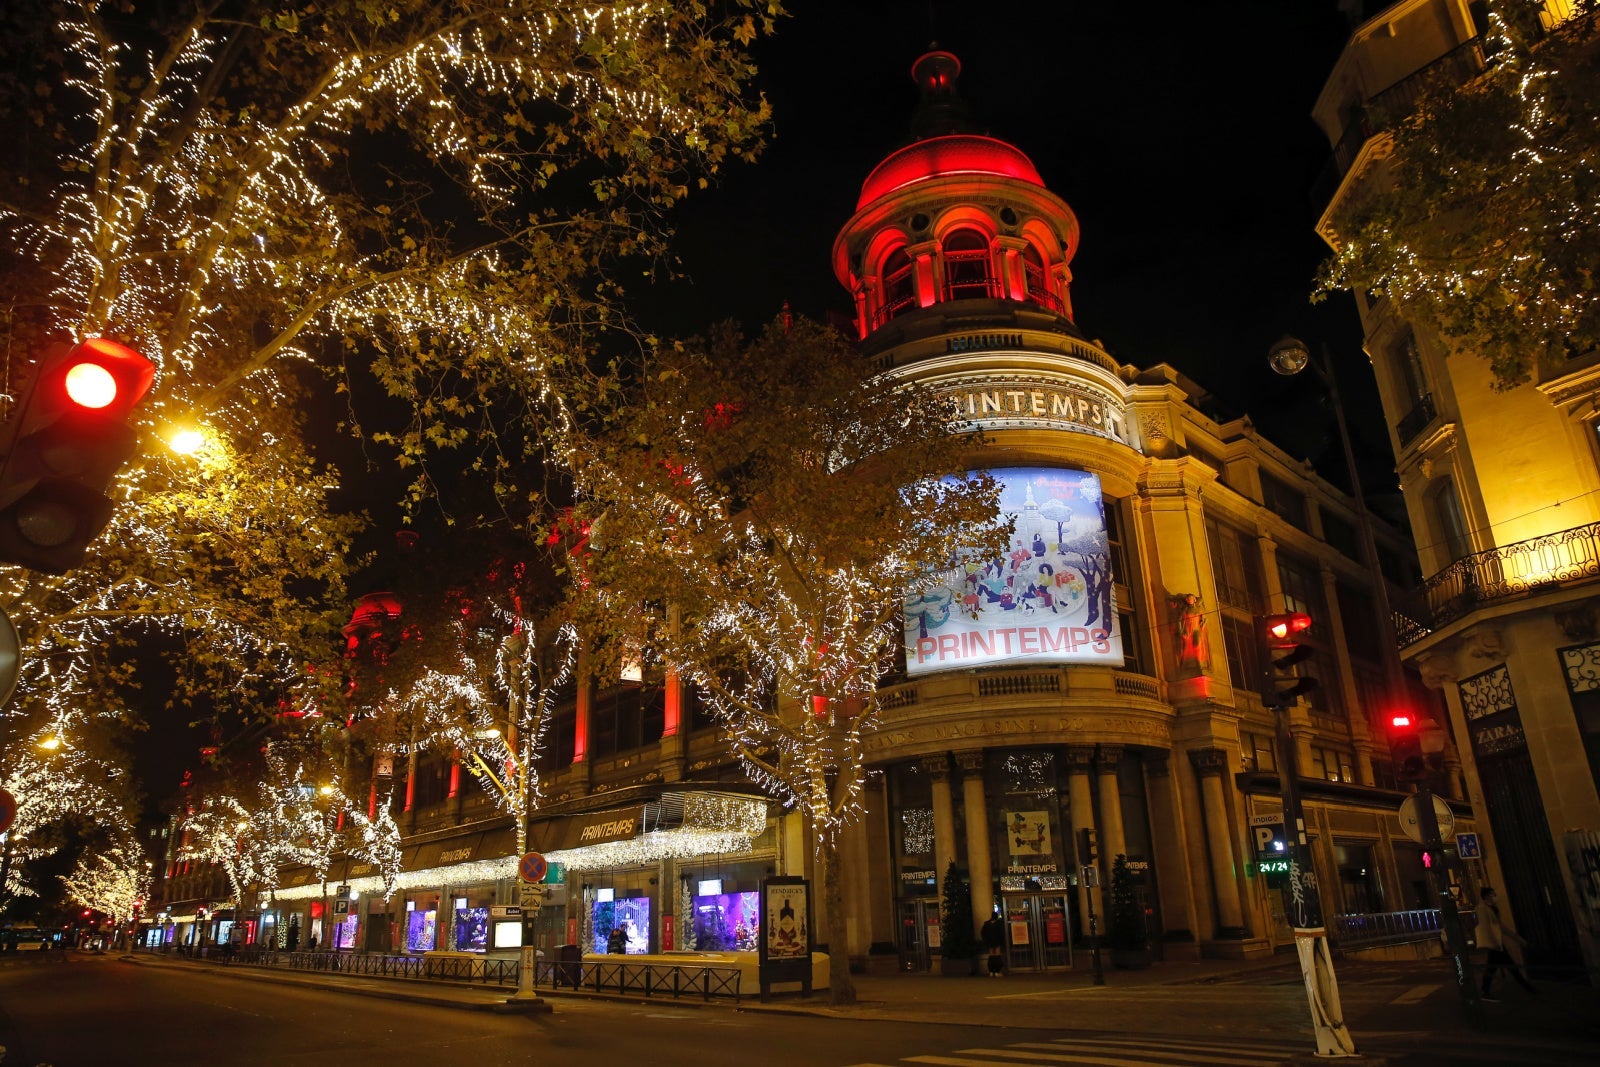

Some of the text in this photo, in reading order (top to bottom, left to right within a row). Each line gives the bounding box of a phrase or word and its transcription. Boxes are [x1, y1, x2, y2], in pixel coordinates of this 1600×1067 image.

[916, 627, 1110, 664] PRINTEMPS
[935, 719, 1036, 738] MAGASINS
[1059, 717, 1085, 731] DU
[1477, 724, 1517, 744] ZARA
[1253, 815, 1278, 824] INDIGO
[580, 818, 634, 841] PRINTEMPS
[1255, 827, 1274, 852] P
[439, 847, 472, 862] PRINTEMPS
[901, 870, 936, 881] PRINTEMPS
[1007, 864, 1057, 874] PRINTEMPS
[338, 902, 346, 912] P
